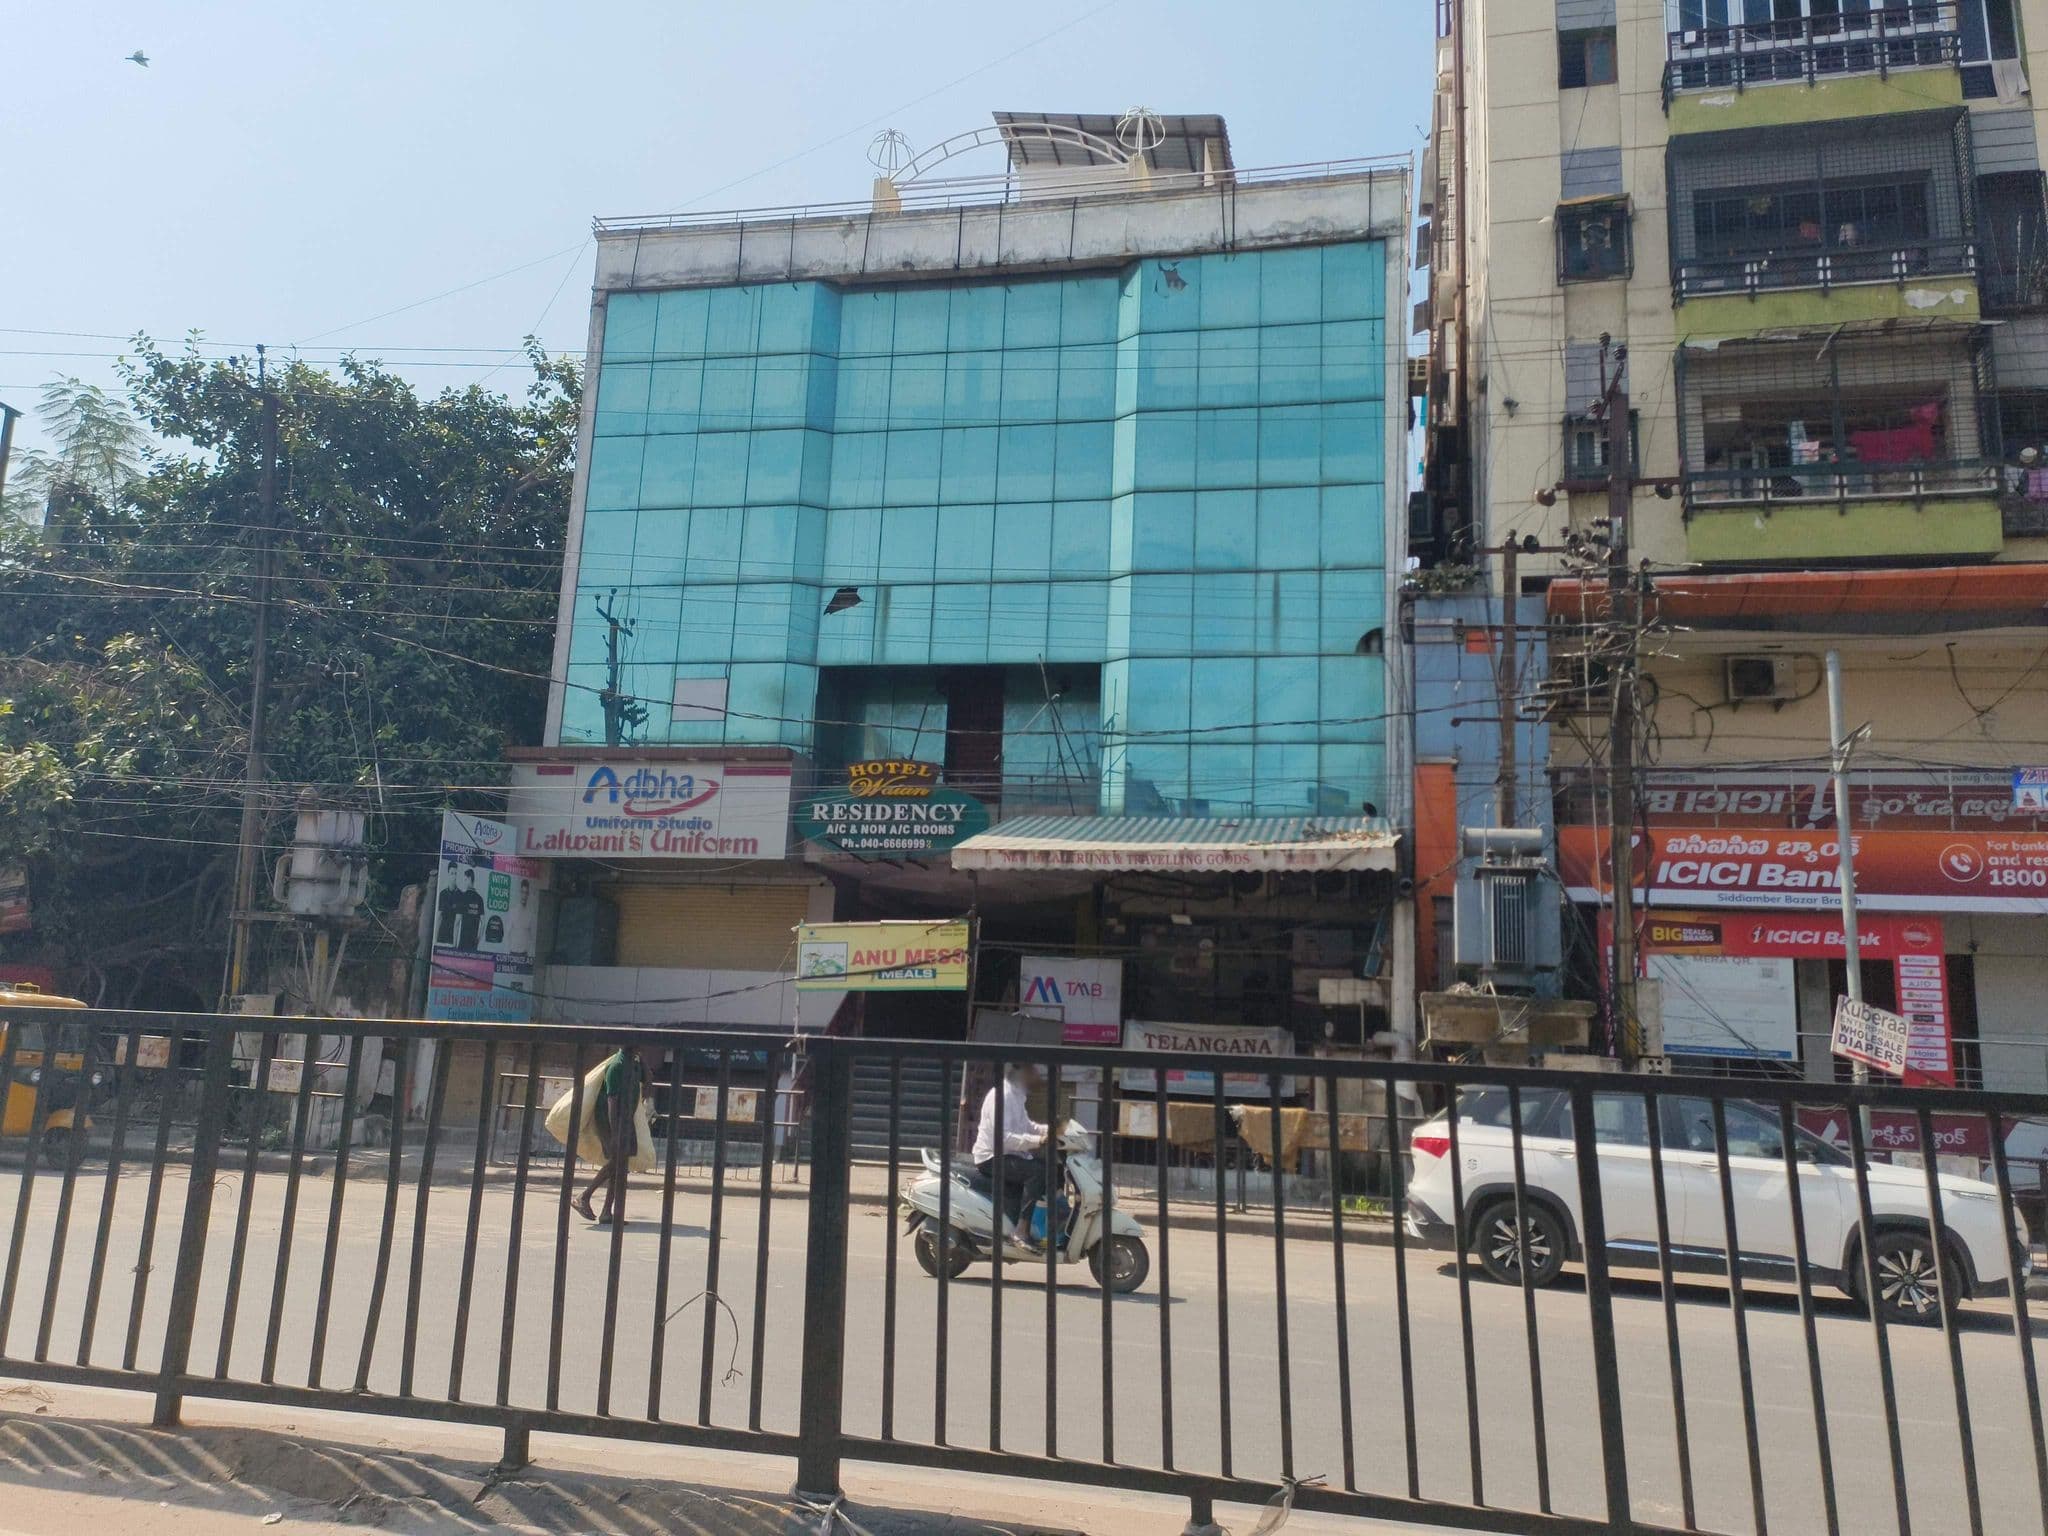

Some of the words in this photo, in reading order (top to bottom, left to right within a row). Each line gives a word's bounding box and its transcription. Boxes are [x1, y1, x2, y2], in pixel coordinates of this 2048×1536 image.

[849, 761, 932, 777] HOTEL
[582, 765, 695, 804] Adbha
[1682, 790, 1785, 814] ICICI
[812, 803, 967, 822] RESIDENCY
[586, 815, 654, 831] Uniform
[657, 815, 714, 831] Studio
[826, 823, 847, 835] A/C
[849, 824, 858, 834] &
[860, 824, 887, 835] NON
[889, 824, 910, 835] A/C
[913, 825, 956, 836] ROOMS
[649, 829, 759, 855] Uniform
[1666, 834, 1770, 856] ఐసీఐసీఐ
[1986, 840, 2009, 852] For
[1127, 852, 1202, 865] TRAVELLING
[1206, 853, 1250, 865] GOODS
[1988, 853, 2020, 866] and
[1657, 861, 1753, 886] ICICI
[1757, 863, 1860, 888] Bank
[1989, 868, 2047, 887] 1800
[490, 886, 509, 898] YOUR
[1718, 893, 1781, 905] Siddiamber
[1785, 895, 1818, 905] Bazar
[1822, 896, 1862, 906] Brah
[488, 898, 508, 911] LOGO
[1652, 926, 1682, 941] BIG
[1766, 930, 1819, 945] ICICI
[852, 949, 897, 966] ANU
[905, 948, 966, 966] MESS
[881, 969, 933, 979] MEALS
[1064, 981, 1103, 997] TMB
[1840, 997, 1907, 1035] Kuberaa
[1840, 1015, 1905, 1044] ENTERPRISES
[1144, 1032, 1273, 1055] TELANGANA
[1840, 1024, 1904, 1054] WHOLESALE
[1838, 1033, 1904, 1066] DIAPERS
